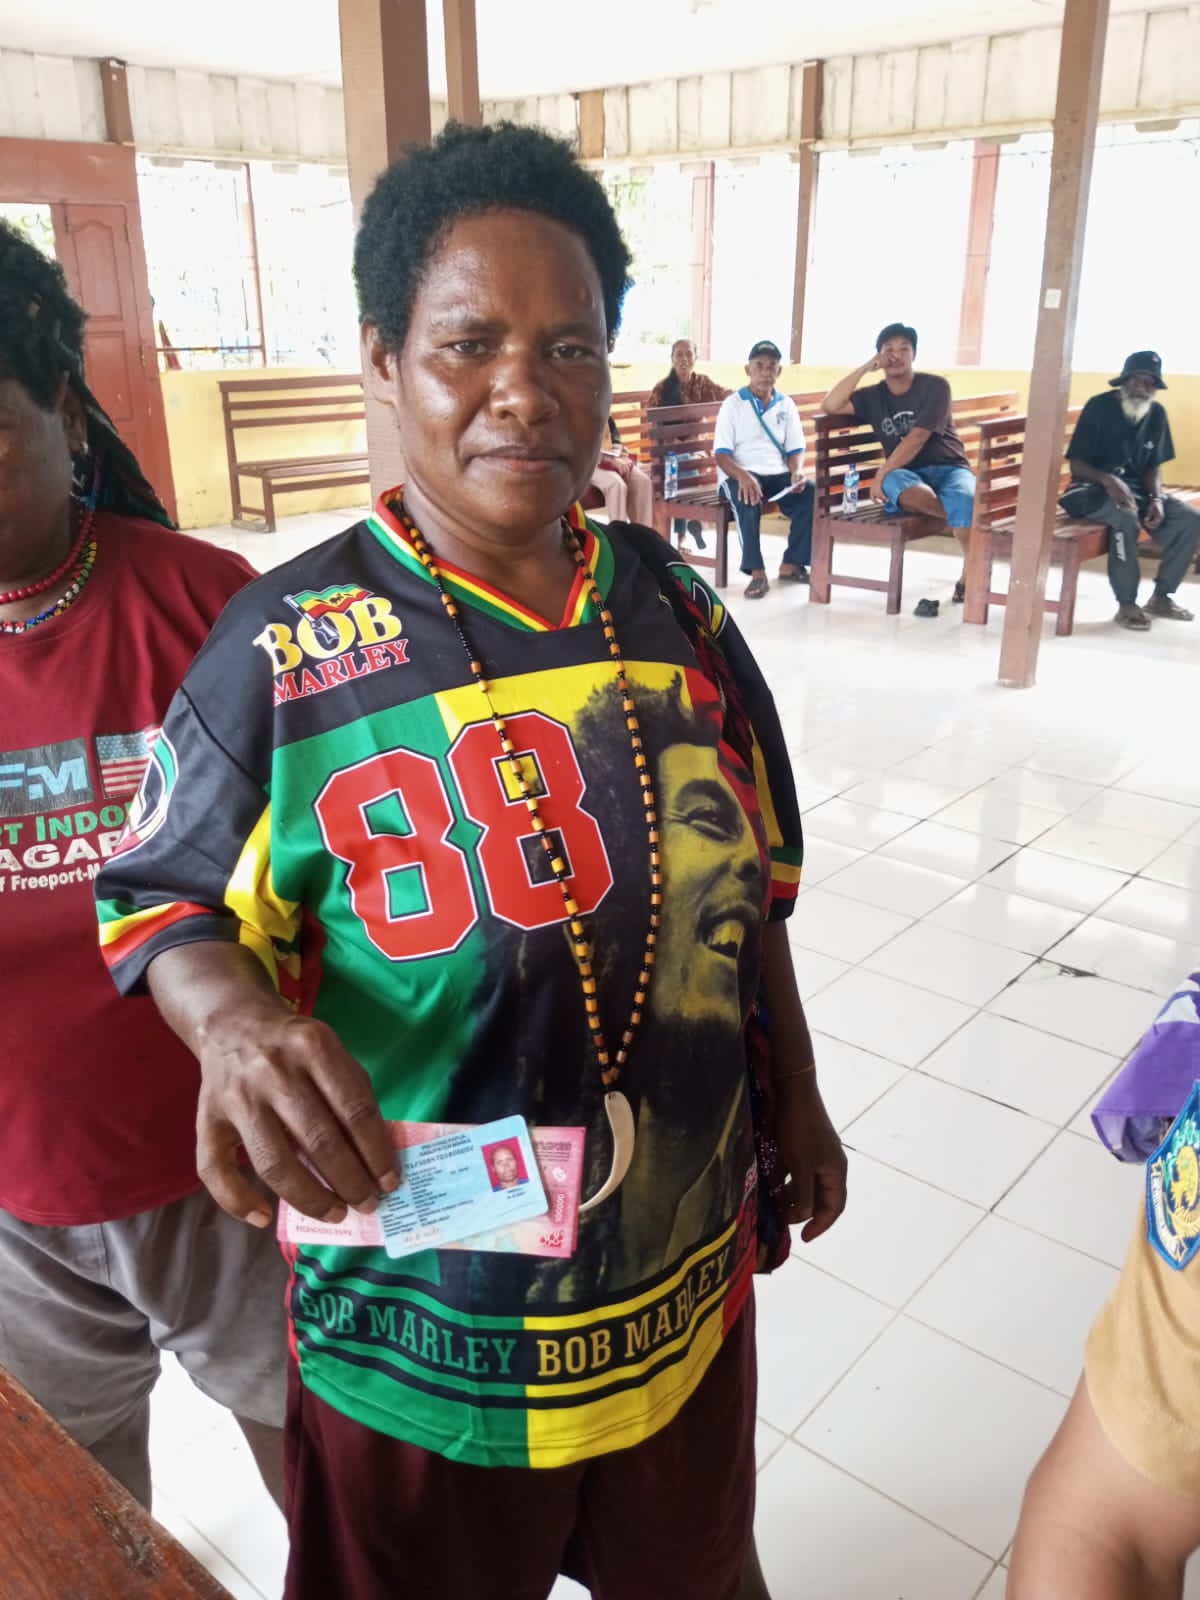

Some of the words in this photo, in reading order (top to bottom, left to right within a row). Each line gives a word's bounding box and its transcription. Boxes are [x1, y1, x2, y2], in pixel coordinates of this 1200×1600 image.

[252, 596, 403, 676] BOB
[272, 638, 411, 707] MARLEY
[35, 801, 133, 842] INDO
[312, 708, 615, 963] 88
[367, 1304, 518, 1375] MARLEY
[536, 1328, 613, 1377] BOB
[623, 1245, 731, 1359] MARLEY
